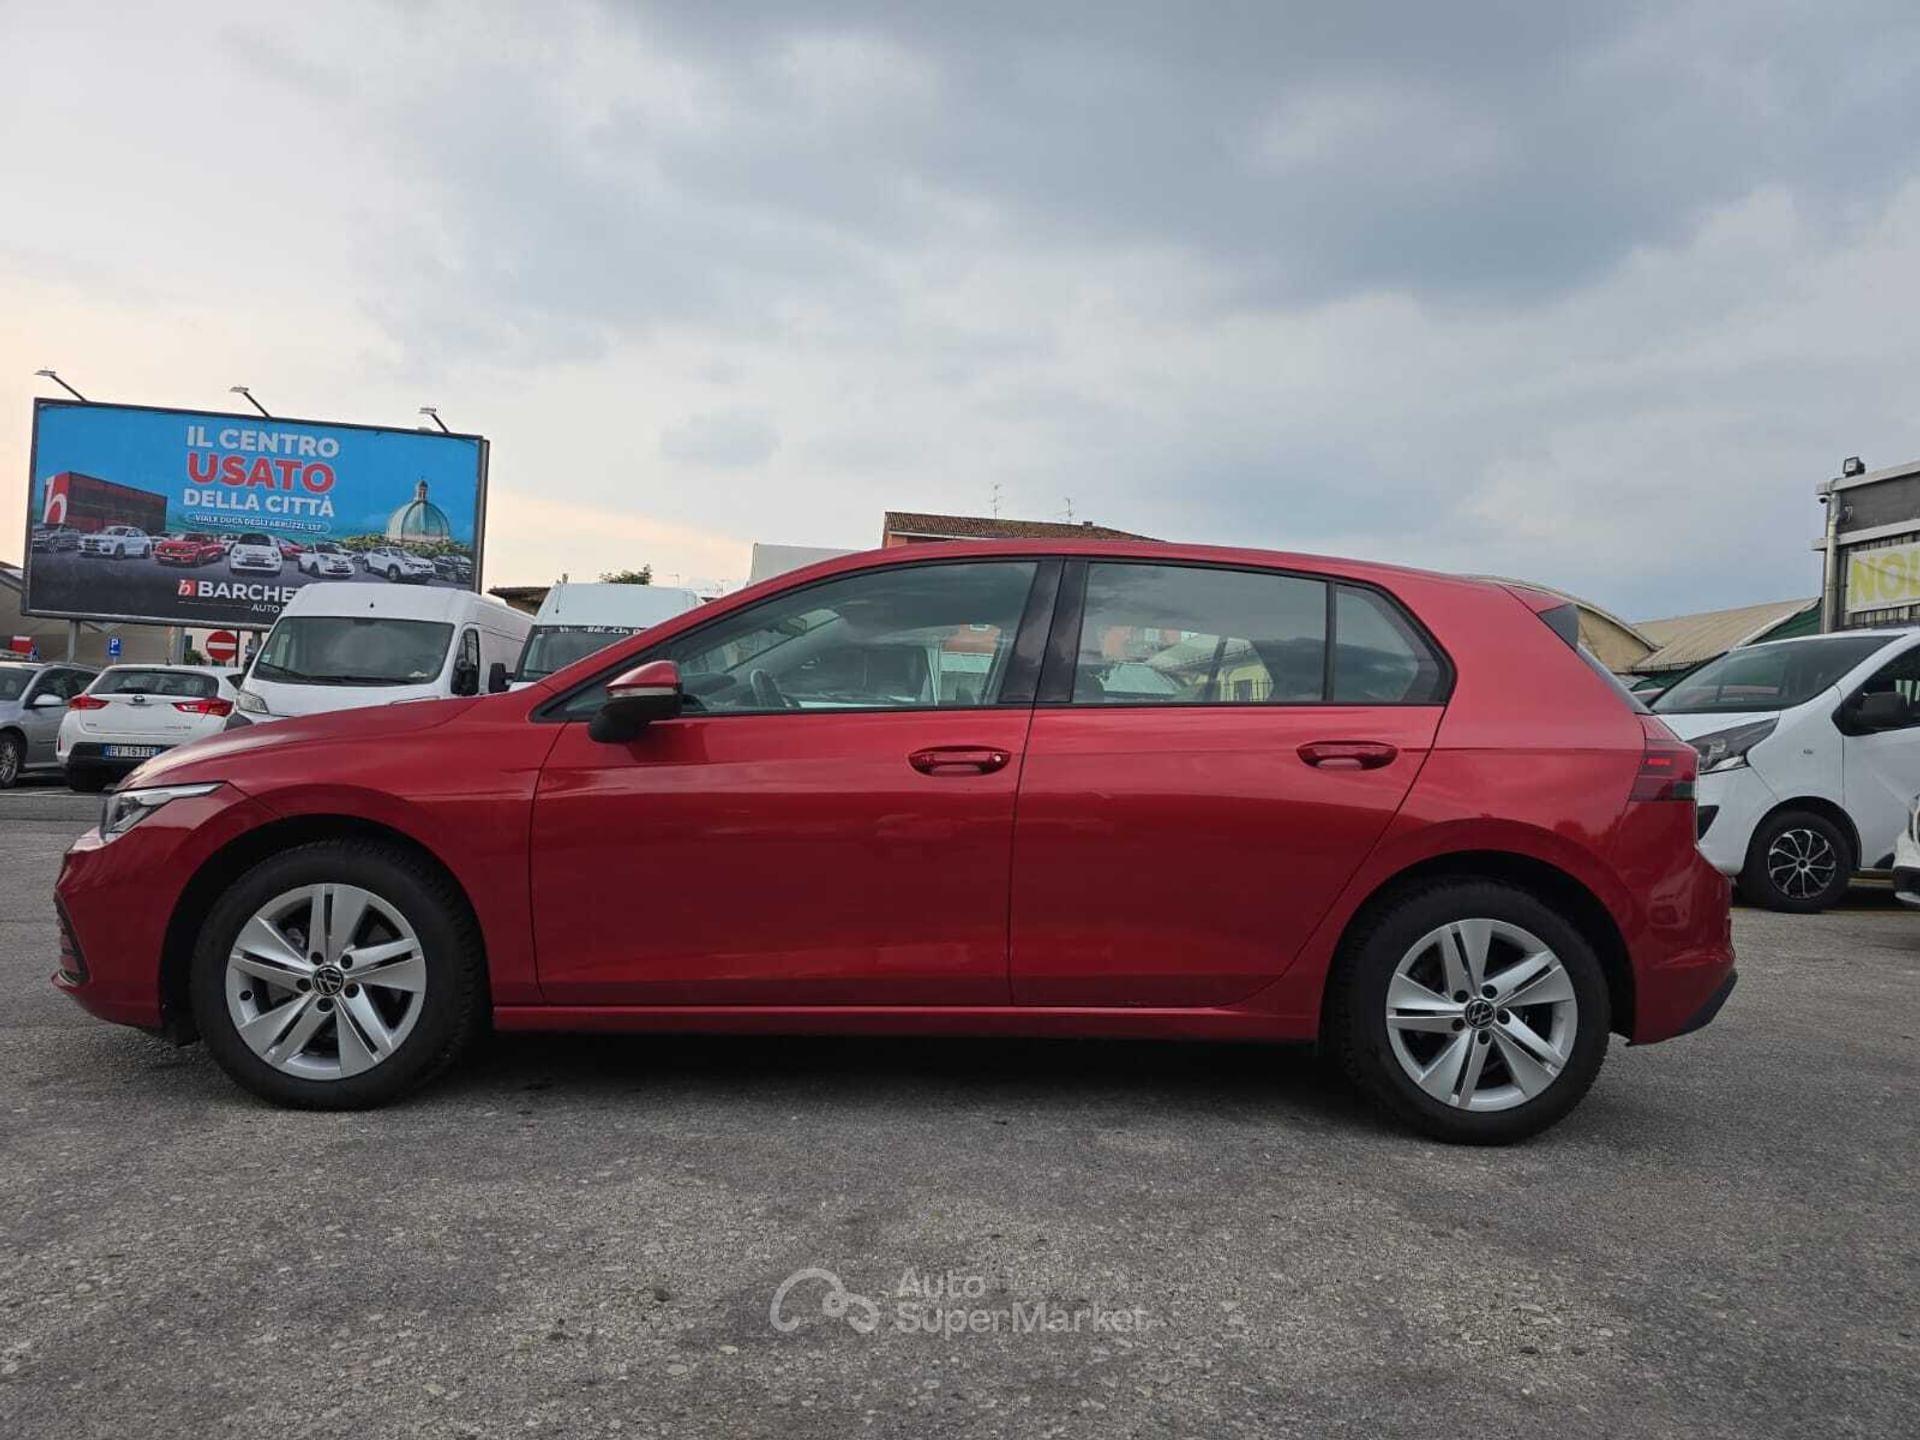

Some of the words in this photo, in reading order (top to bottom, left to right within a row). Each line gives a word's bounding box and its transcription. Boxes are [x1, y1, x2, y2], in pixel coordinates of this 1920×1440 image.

[187, 425, 213, 448] IL
[219, 428, 339, 458] CENTRO
[188, 451, 336, 494] USATO
[183, 488, 260, 511] DELLA
[265, 495, 334, 518] CITTÀ
[195, 514, 218, 522] VIALE
[220, 516, 243, 524] DUCA
[244, 518, 268, 526] DEGLI
[198, 581, 300, 603] BARCHE
[251, 603, 280, 613] AUTO
[111, 638, 119, 648] P
